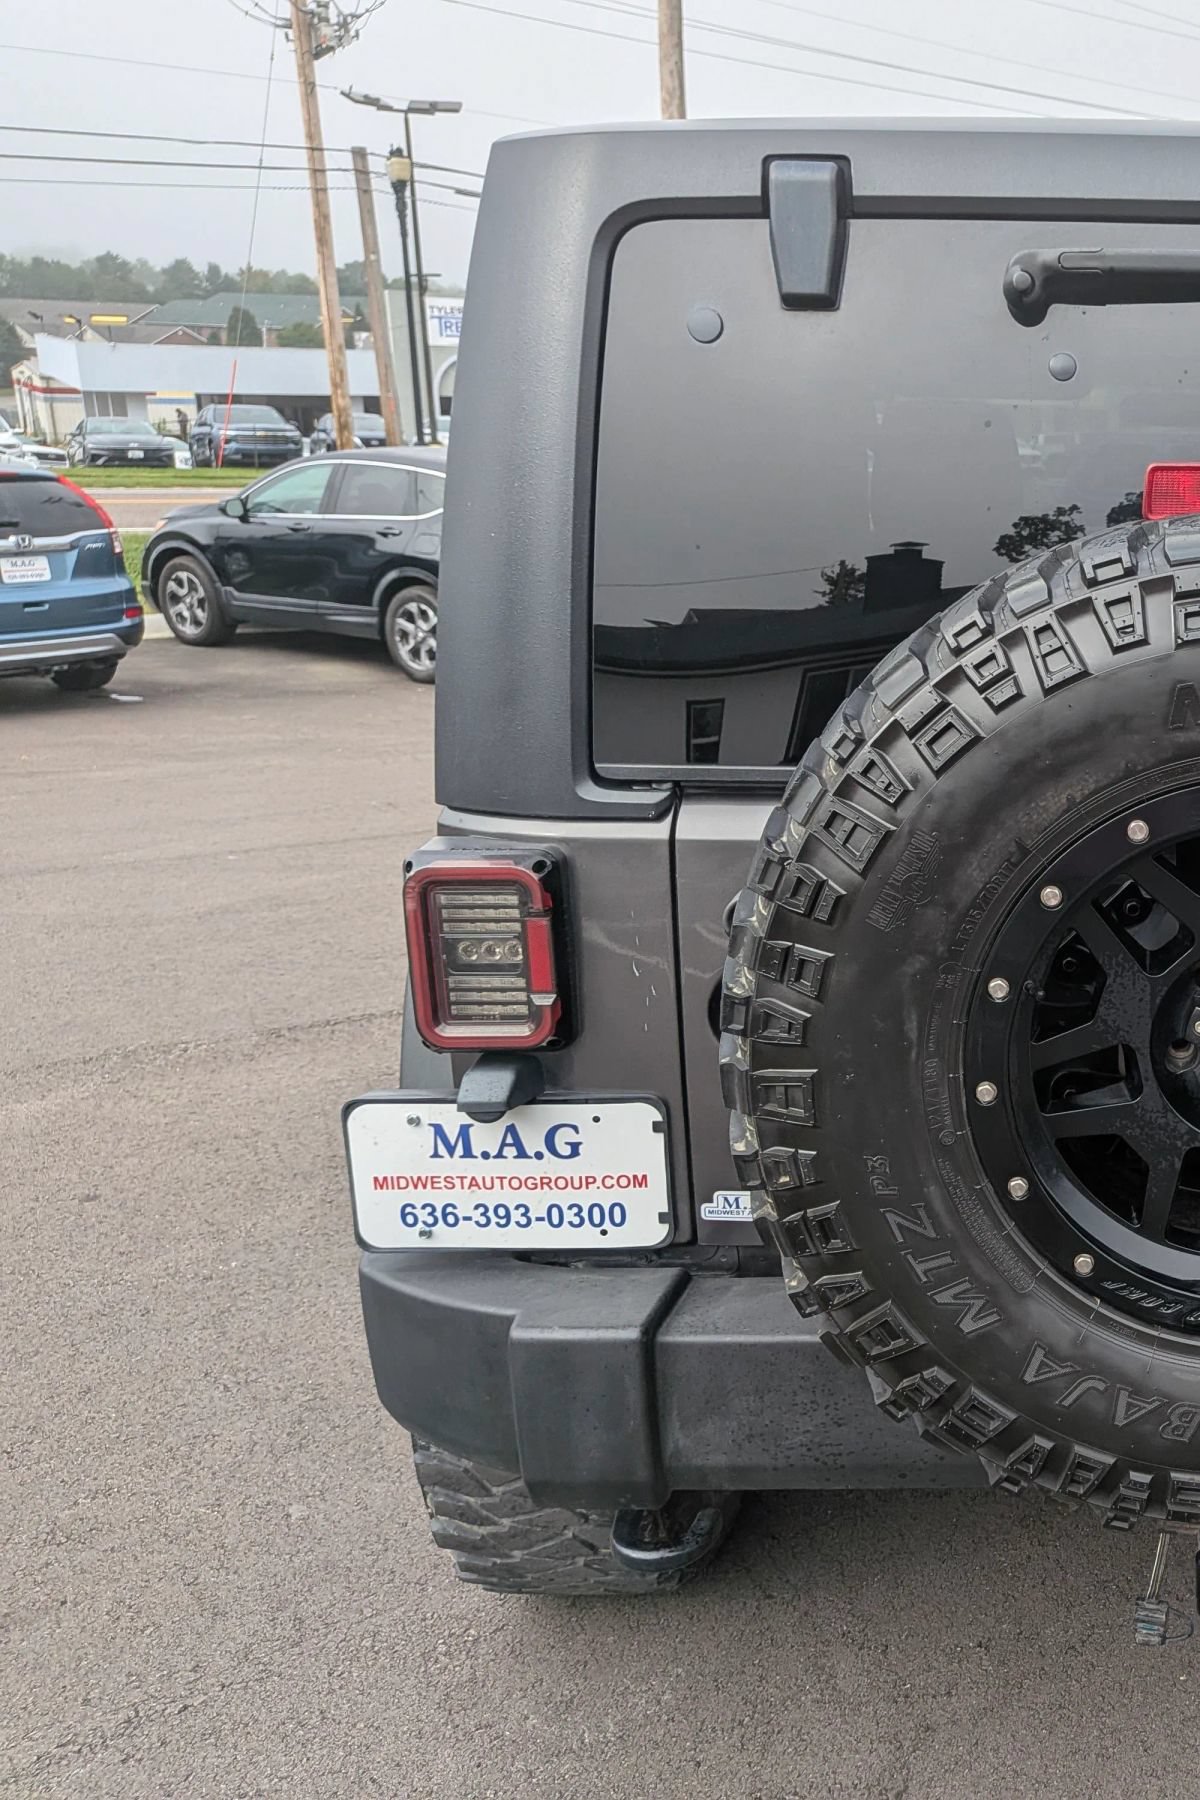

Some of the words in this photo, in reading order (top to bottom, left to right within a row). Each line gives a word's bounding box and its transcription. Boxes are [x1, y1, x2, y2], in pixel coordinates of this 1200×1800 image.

[428, 1122, 584, 1160] M.A.G
[372, 1173, 649, 1191] MIDWESTAUTOGROUP.COM
[399, 1202, 627, 1229] 636-393-0300
[879, 1202, 1003, 1335] MTZ
